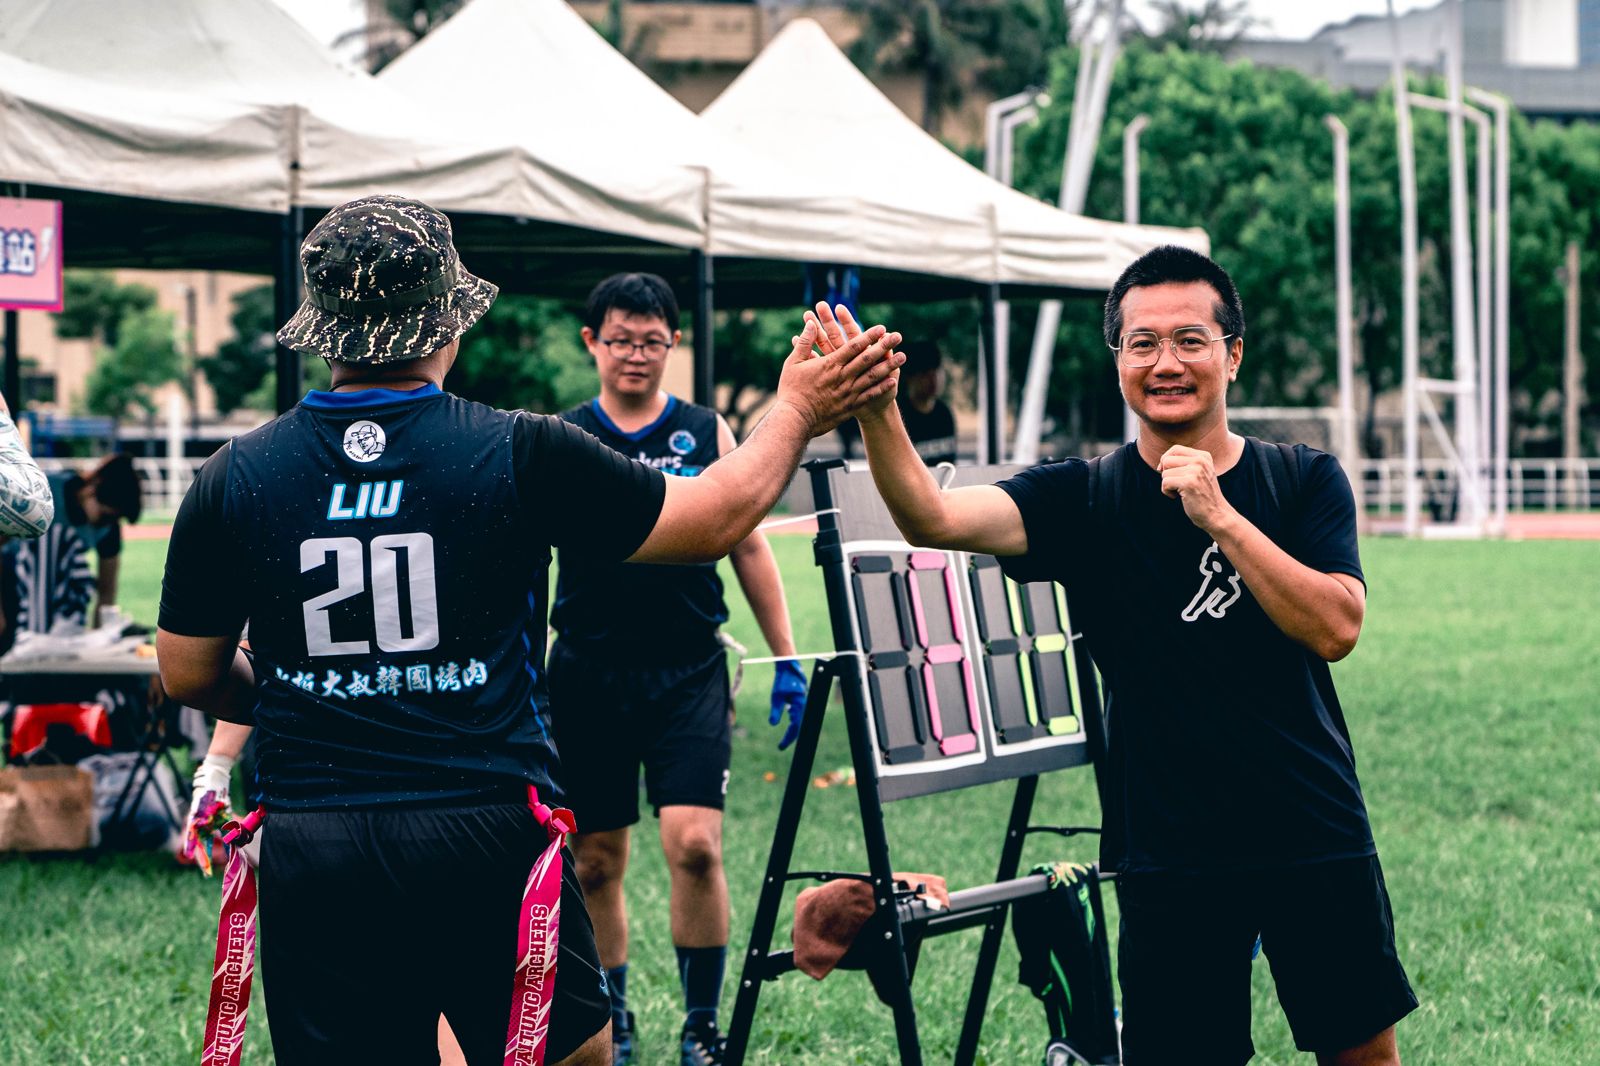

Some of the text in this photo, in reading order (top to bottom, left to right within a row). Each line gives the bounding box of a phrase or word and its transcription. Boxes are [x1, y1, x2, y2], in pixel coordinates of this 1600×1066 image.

[0, 226, 36, 276] 站
[631, 451, 683, 469] kers
[327, 480, 404, 520] LIU
[300, 532, 440, 657] 20
[222, 912, 248, 1001] ARCHERS
[525, 903, 550, 991] ARCHERS
